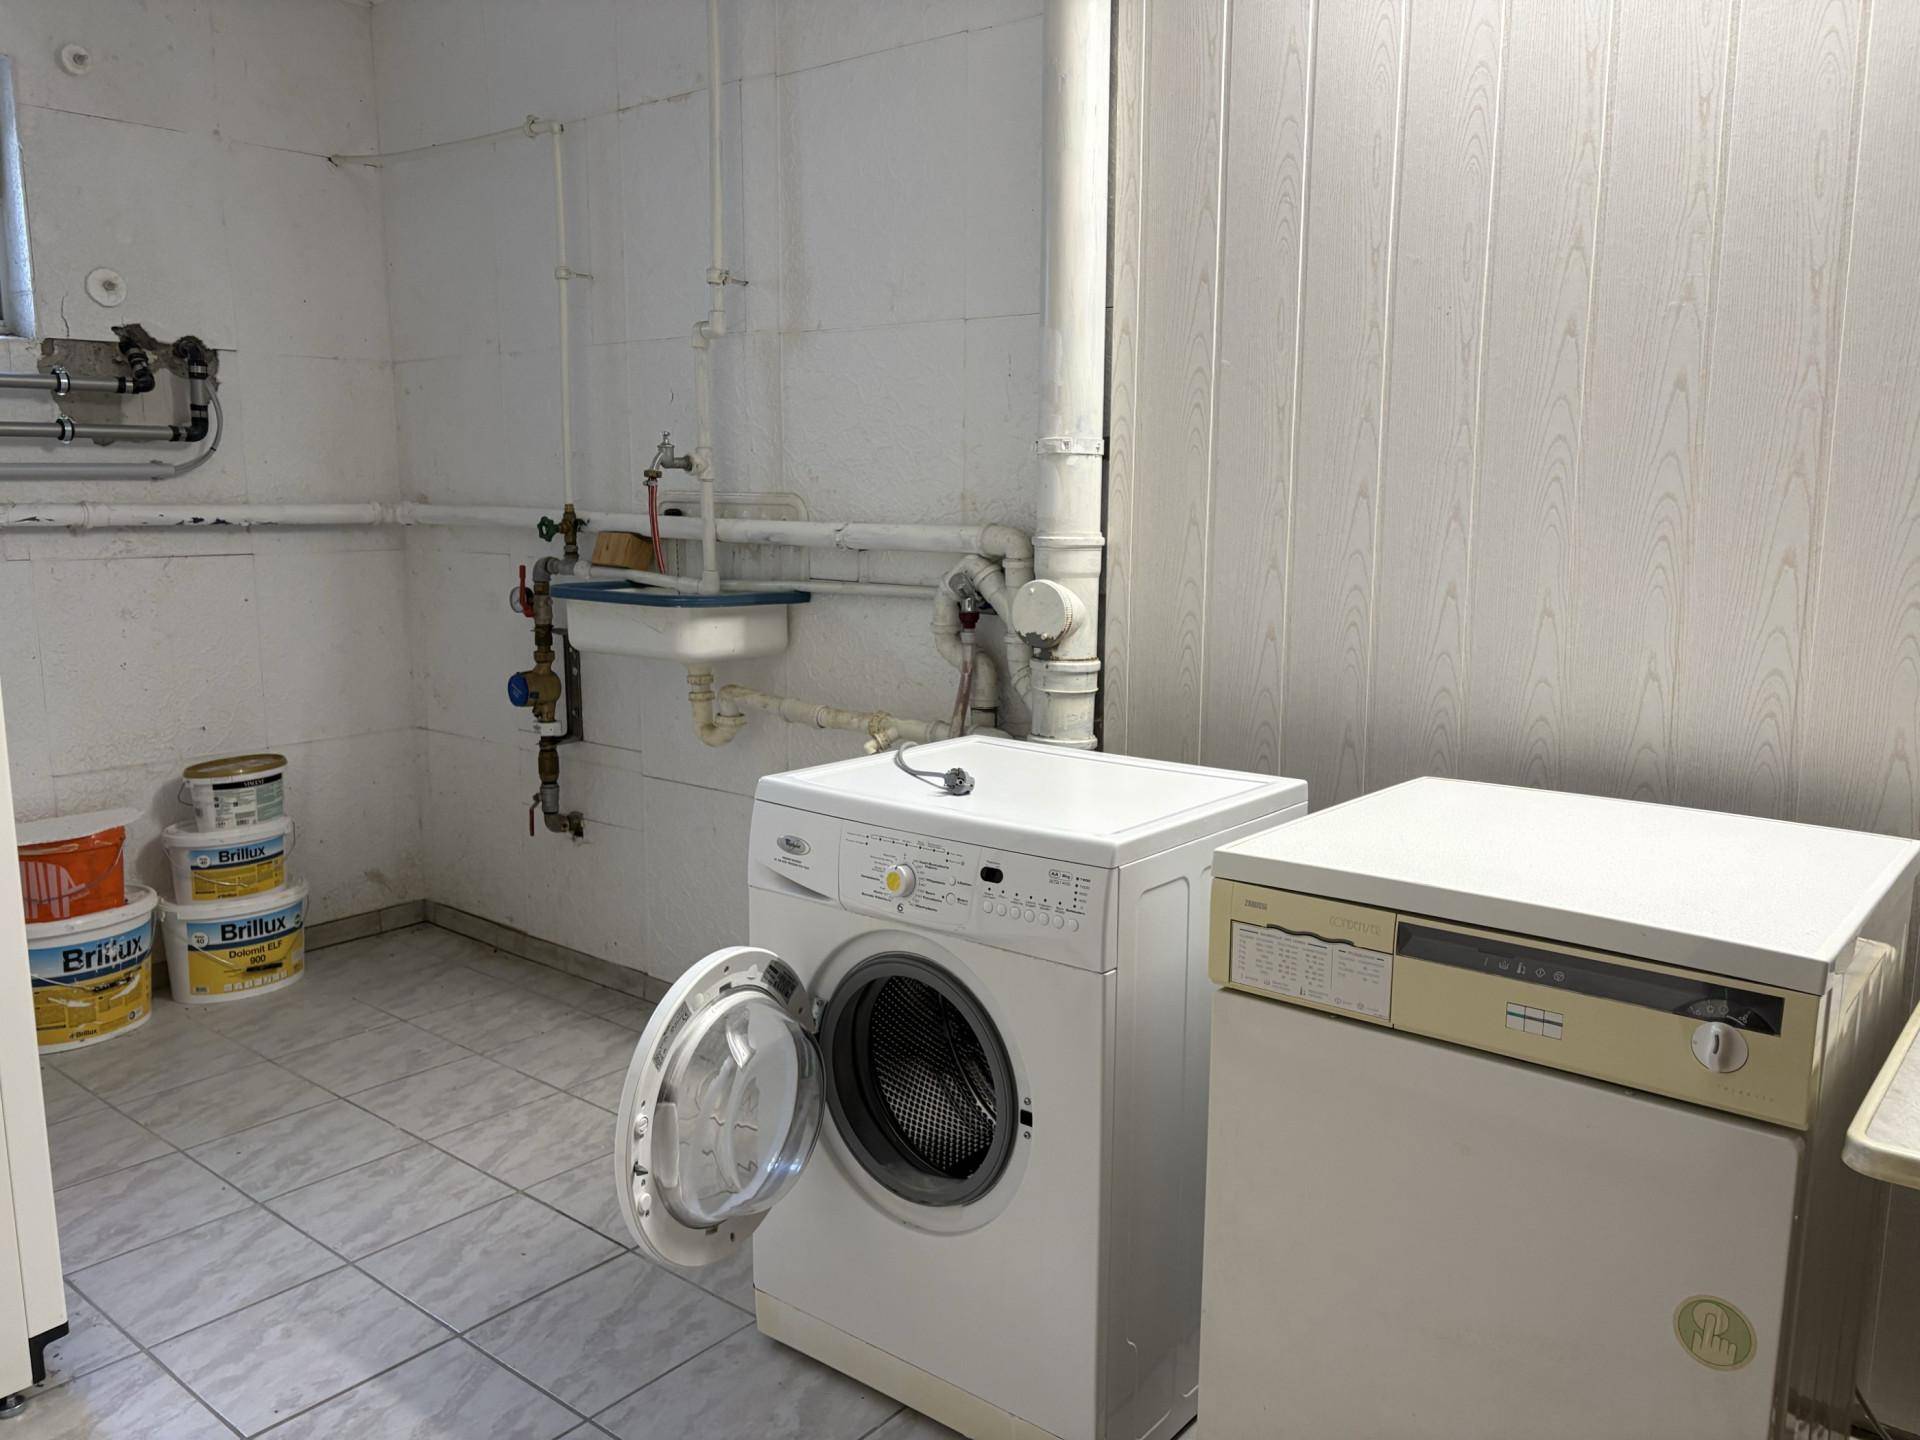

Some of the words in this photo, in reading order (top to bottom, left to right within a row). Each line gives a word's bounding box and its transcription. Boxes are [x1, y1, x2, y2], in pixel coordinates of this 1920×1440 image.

[218, 846, 266, 863] Brillux
[897, 902, 904, 912] 6
[220, 915, 286, 942] Brillux
[229, 945, 265, 959] Dolomit
[267, 940, 283, 952] ELF
[250, 954, 266, 965] 900
